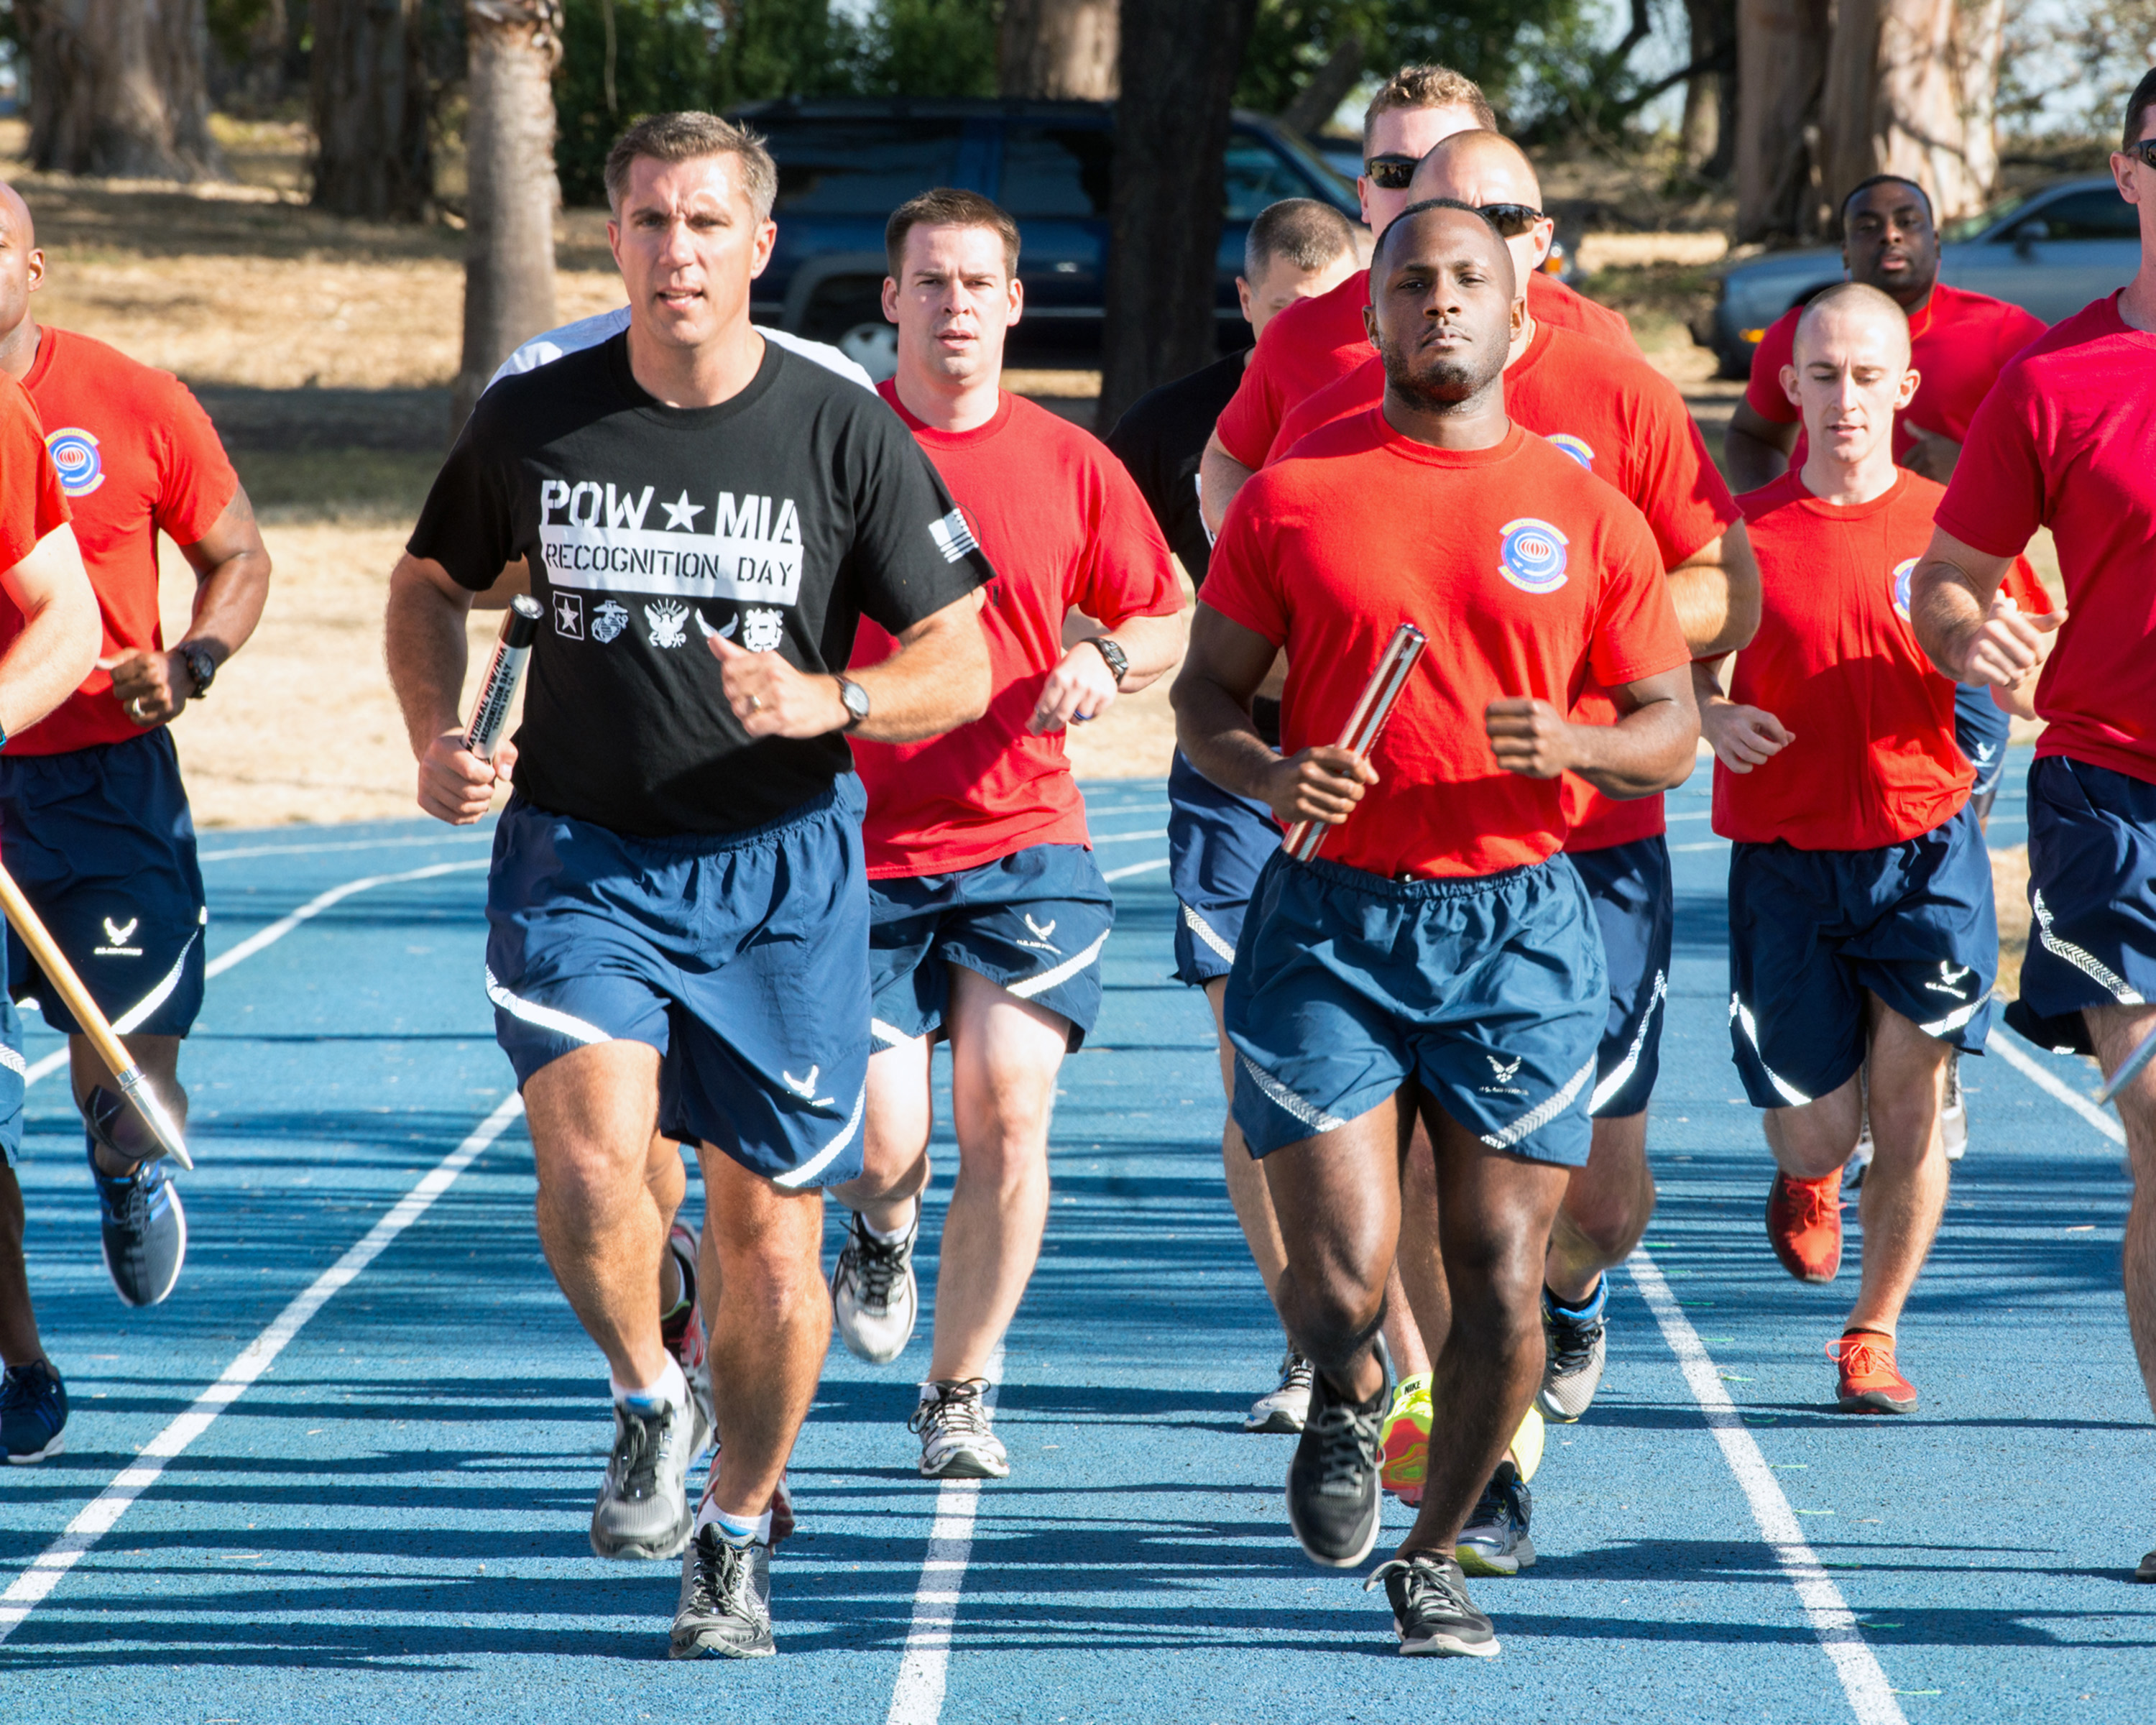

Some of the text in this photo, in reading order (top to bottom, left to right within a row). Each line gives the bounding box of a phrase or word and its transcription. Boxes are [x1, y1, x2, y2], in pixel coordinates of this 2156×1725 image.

[540, 479, 801, 546] POW MIA
[545, 543, 793, 587] RECOGNITION DAY
[466, 647, 507, 753] NATIONAL POW/MIA
[479, 663, 512, 745] RECOGNITION DAY
[1404, 1379, 1422, 1395] NIKE
